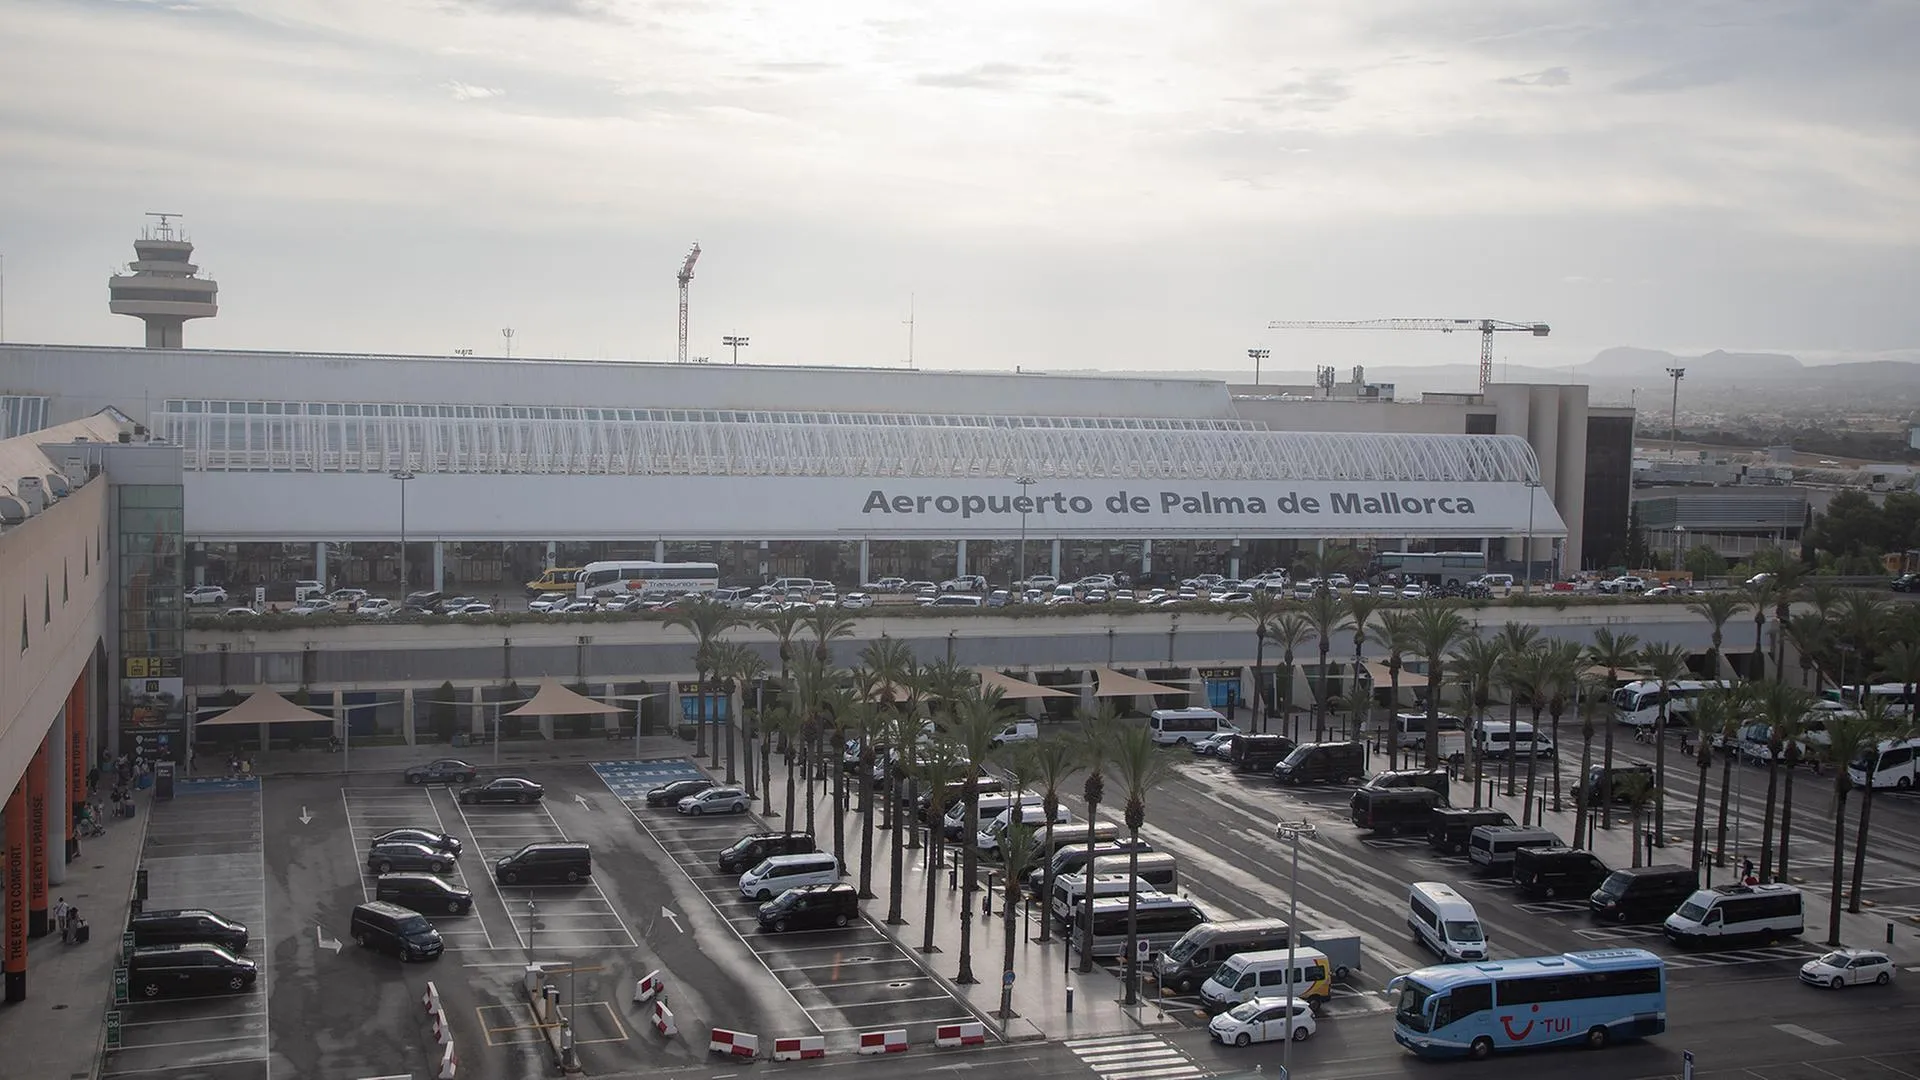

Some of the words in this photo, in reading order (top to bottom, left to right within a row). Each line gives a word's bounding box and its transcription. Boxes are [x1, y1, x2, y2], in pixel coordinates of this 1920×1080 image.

[862, 490, 1092, 518] Aeropuerto
[1106, 490, 1150, 514] de
[1160, 491, 1266, 514] Palma
[1277, 491, 1320, 514] de
[1329, 492, 1476, 514] Mallorca
[32, 846, 43, 858] TO
[11, 842, 22, 897] COMFORT.
[32, 861, 43, 880] KEY
[32, 881, 43, 900] THE
[11, 900, 22, 914] TO
[11, 917, 22, 938] KEY
[11, 940, 22, 961] THE
[1544, 1017, 1571, 1033] TUI
